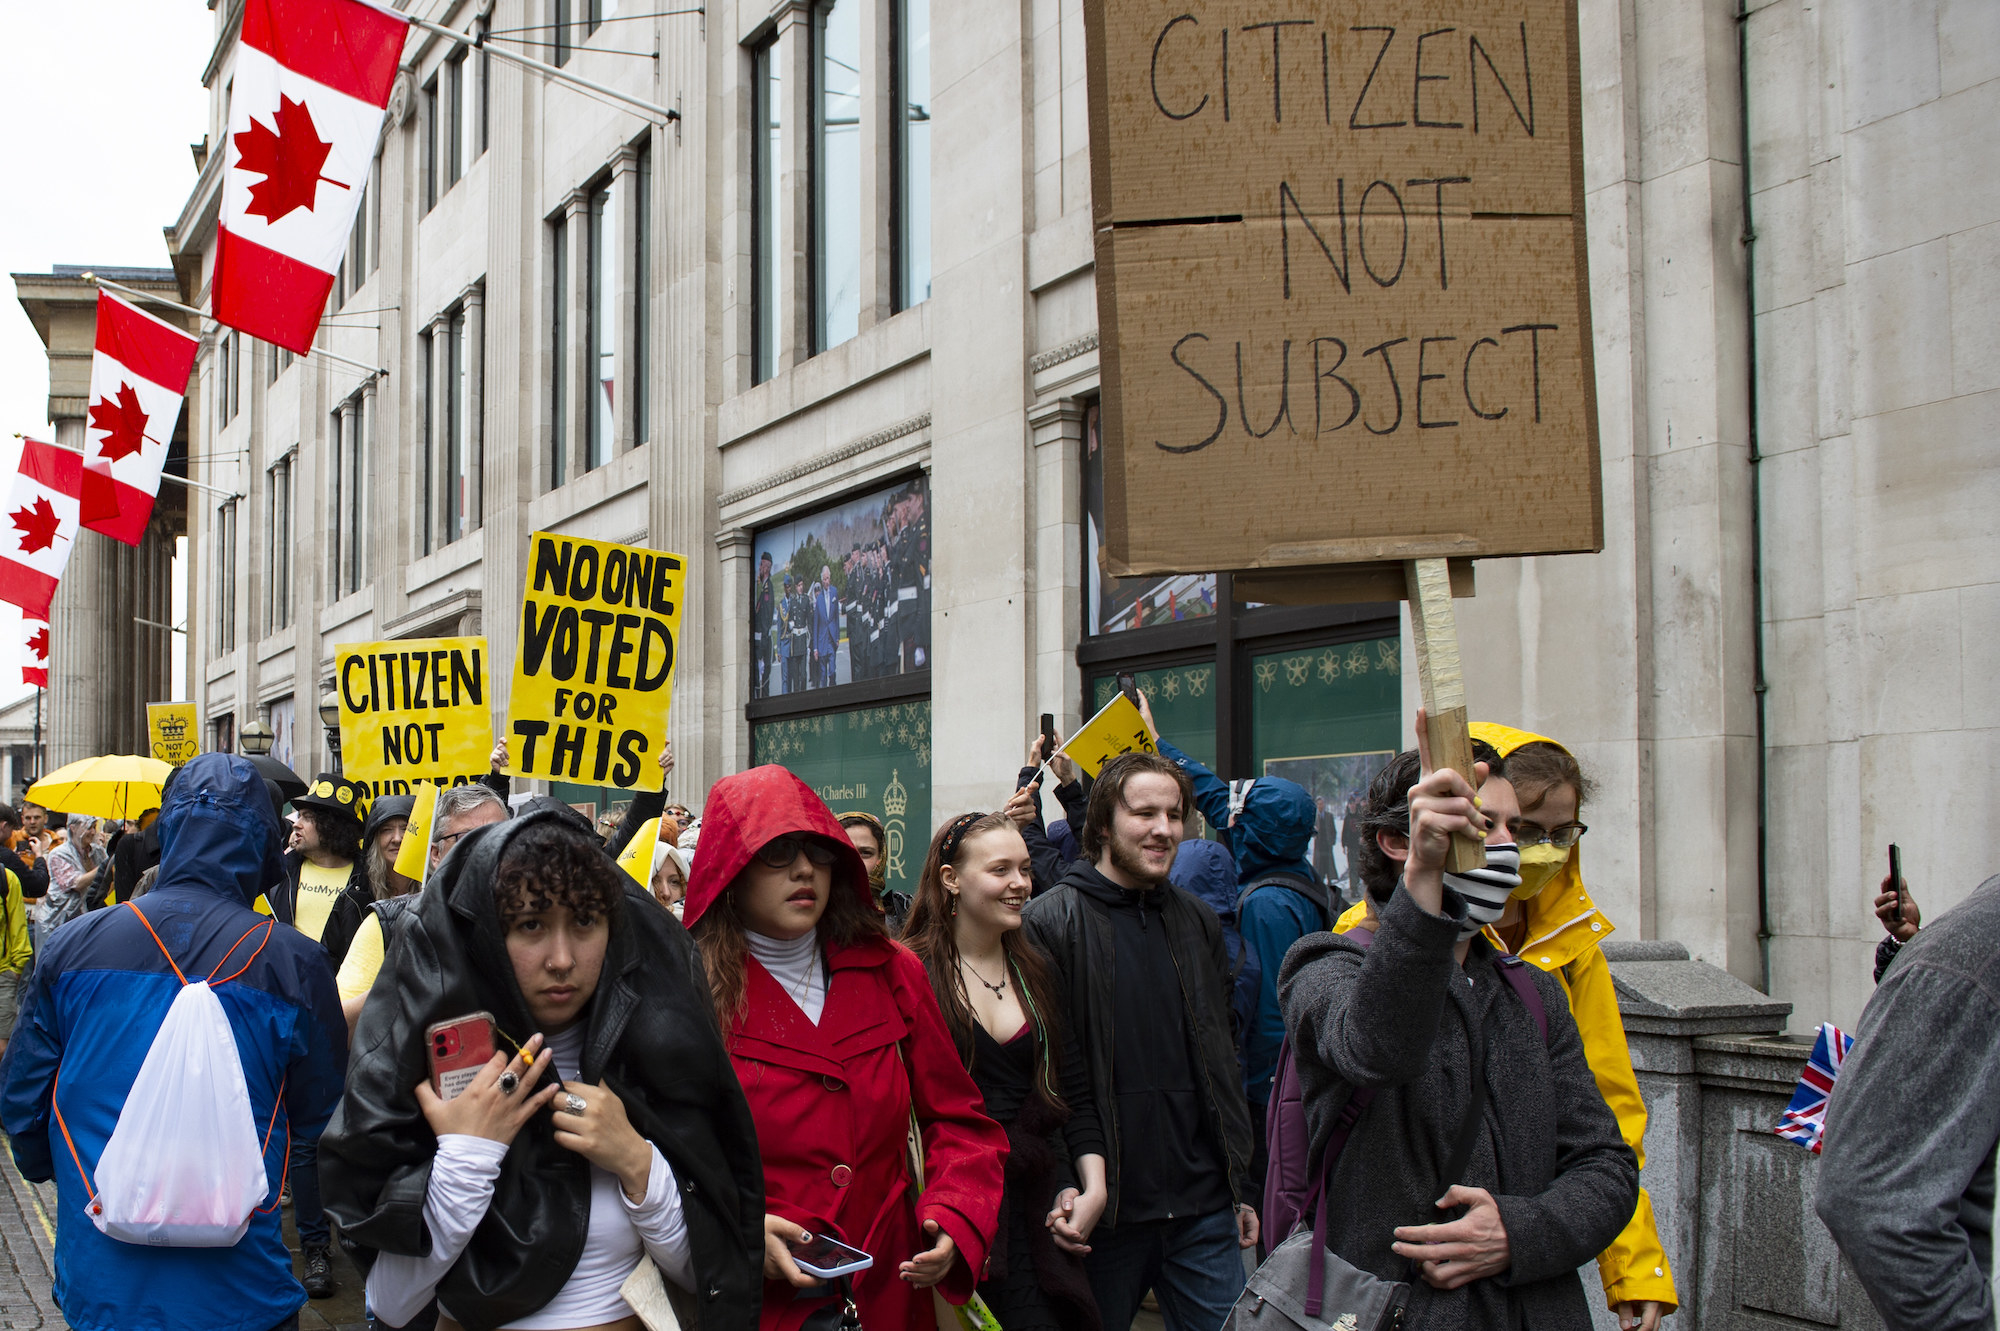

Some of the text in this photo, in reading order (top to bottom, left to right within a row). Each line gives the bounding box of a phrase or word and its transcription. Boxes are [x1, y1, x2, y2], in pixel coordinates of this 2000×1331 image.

[1150, 14, 1535, 137] CITIZEN
[1280, 178, 1472, 299] NOT
[1155, 324, 1559, 454] SUBJECT
[523, 600, 674, 692] VOTED
[342, 649, 482, 714] CITIZEN
[554, 688, 617, 725] FOR
[383, 723, 444, 765] NOT
[513, 719, 648, 788] THIS
[1133, 729, 1154, 755] NO
[822, 784, 854, 800] Charles
[856, 783, 866, 799] III
[298, 882, 343, 897] NotMyK
